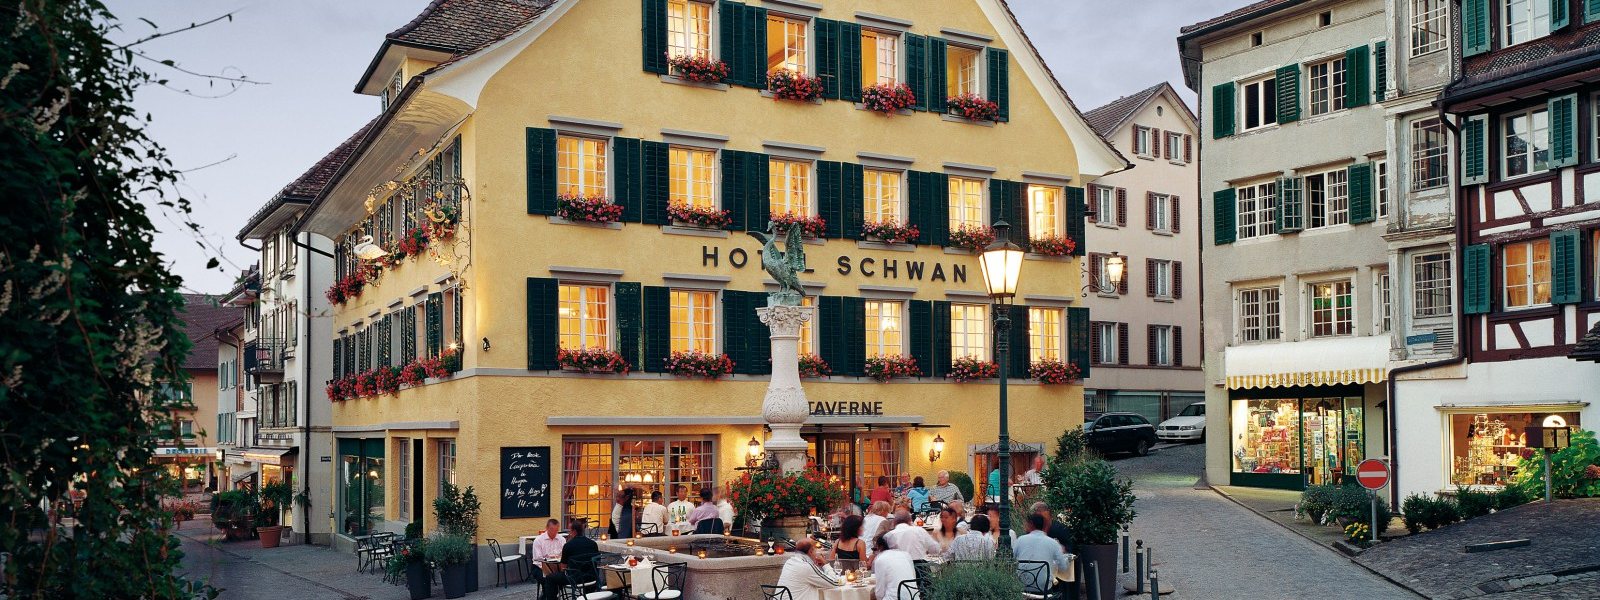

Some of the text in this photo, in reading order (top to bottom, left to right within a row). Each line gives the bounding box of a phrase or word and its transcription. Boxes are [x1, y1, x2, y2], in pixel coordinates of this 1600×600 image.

[702, 246, 967, 283] HOTL SCHWAN
[808, 401, 883, 415] TAVERNE
